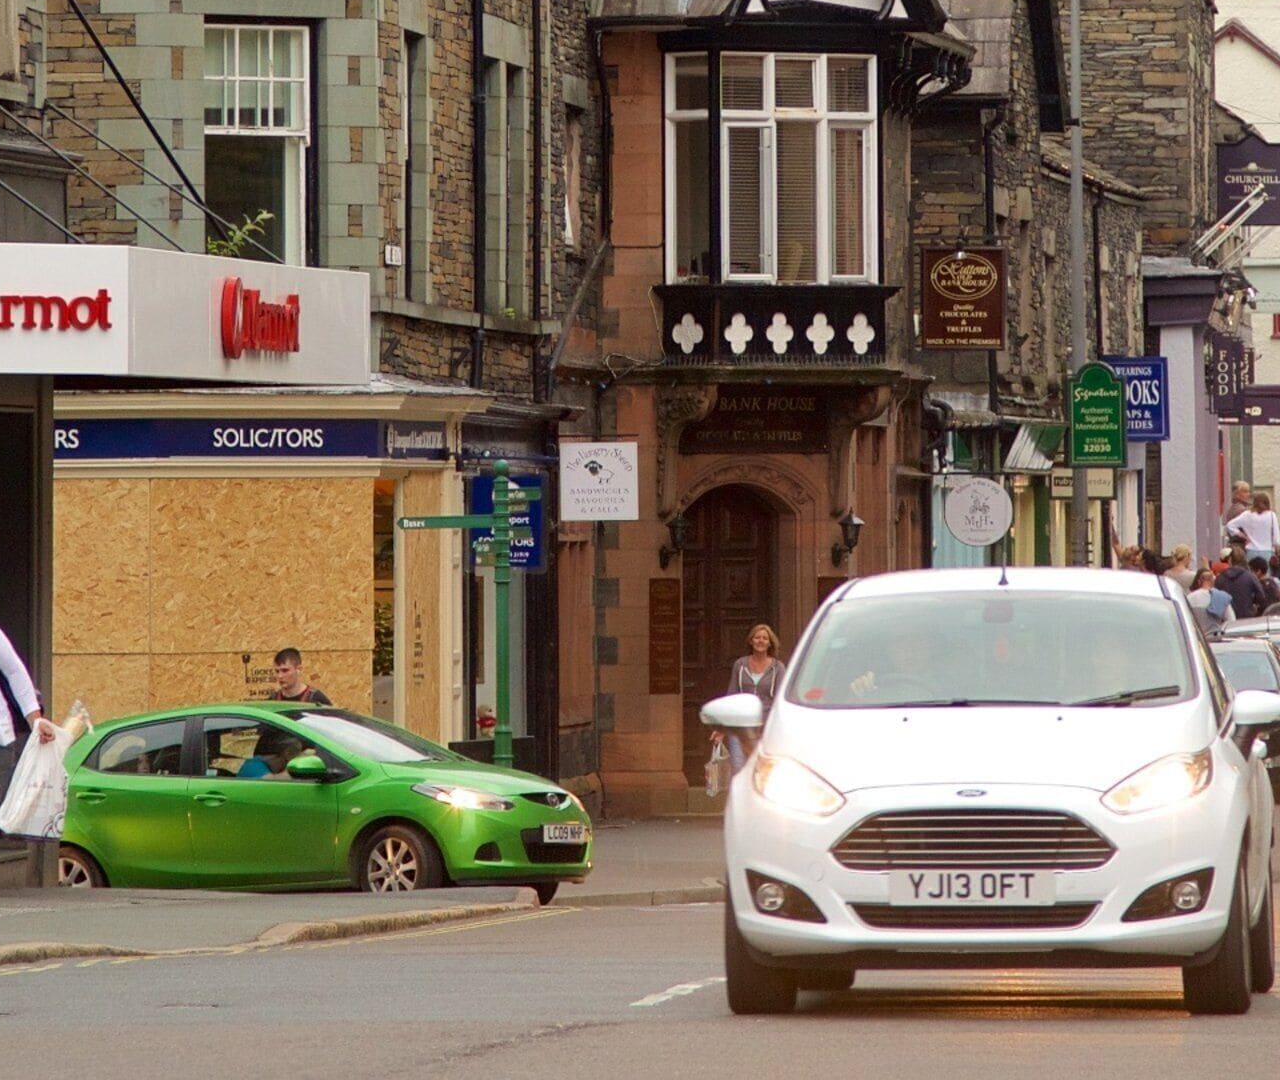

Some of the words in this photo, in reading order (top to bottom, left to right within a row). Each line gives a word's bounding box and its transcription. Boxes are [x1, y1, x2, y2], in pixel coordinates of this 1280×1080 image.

[1224, 175, 1280, 184] CHURCHILL
[1217, 350, 1229, 396] FOOD
[1074, 388, 1119, 402] Signature
[1126, 379, 1160, 406] OKS
[720, 396, 761, 411] BANK
[768, 396, 816, 412] HOUSE
[1080, 407, 1114, 415] Authentic
[1126, 410, 1142, 418] APS
[1144, 410, 1151, 418] &
[1084, 415, 1109, 423] Signed
[213, 428, 324, 449] SOLICITORS
[1083, 444, 1112, 453] 32030
[402, 519, 426, 528] Buses
[908, 873, 970, 899] YJ13
[980, 873, 1035, 899] OFT
